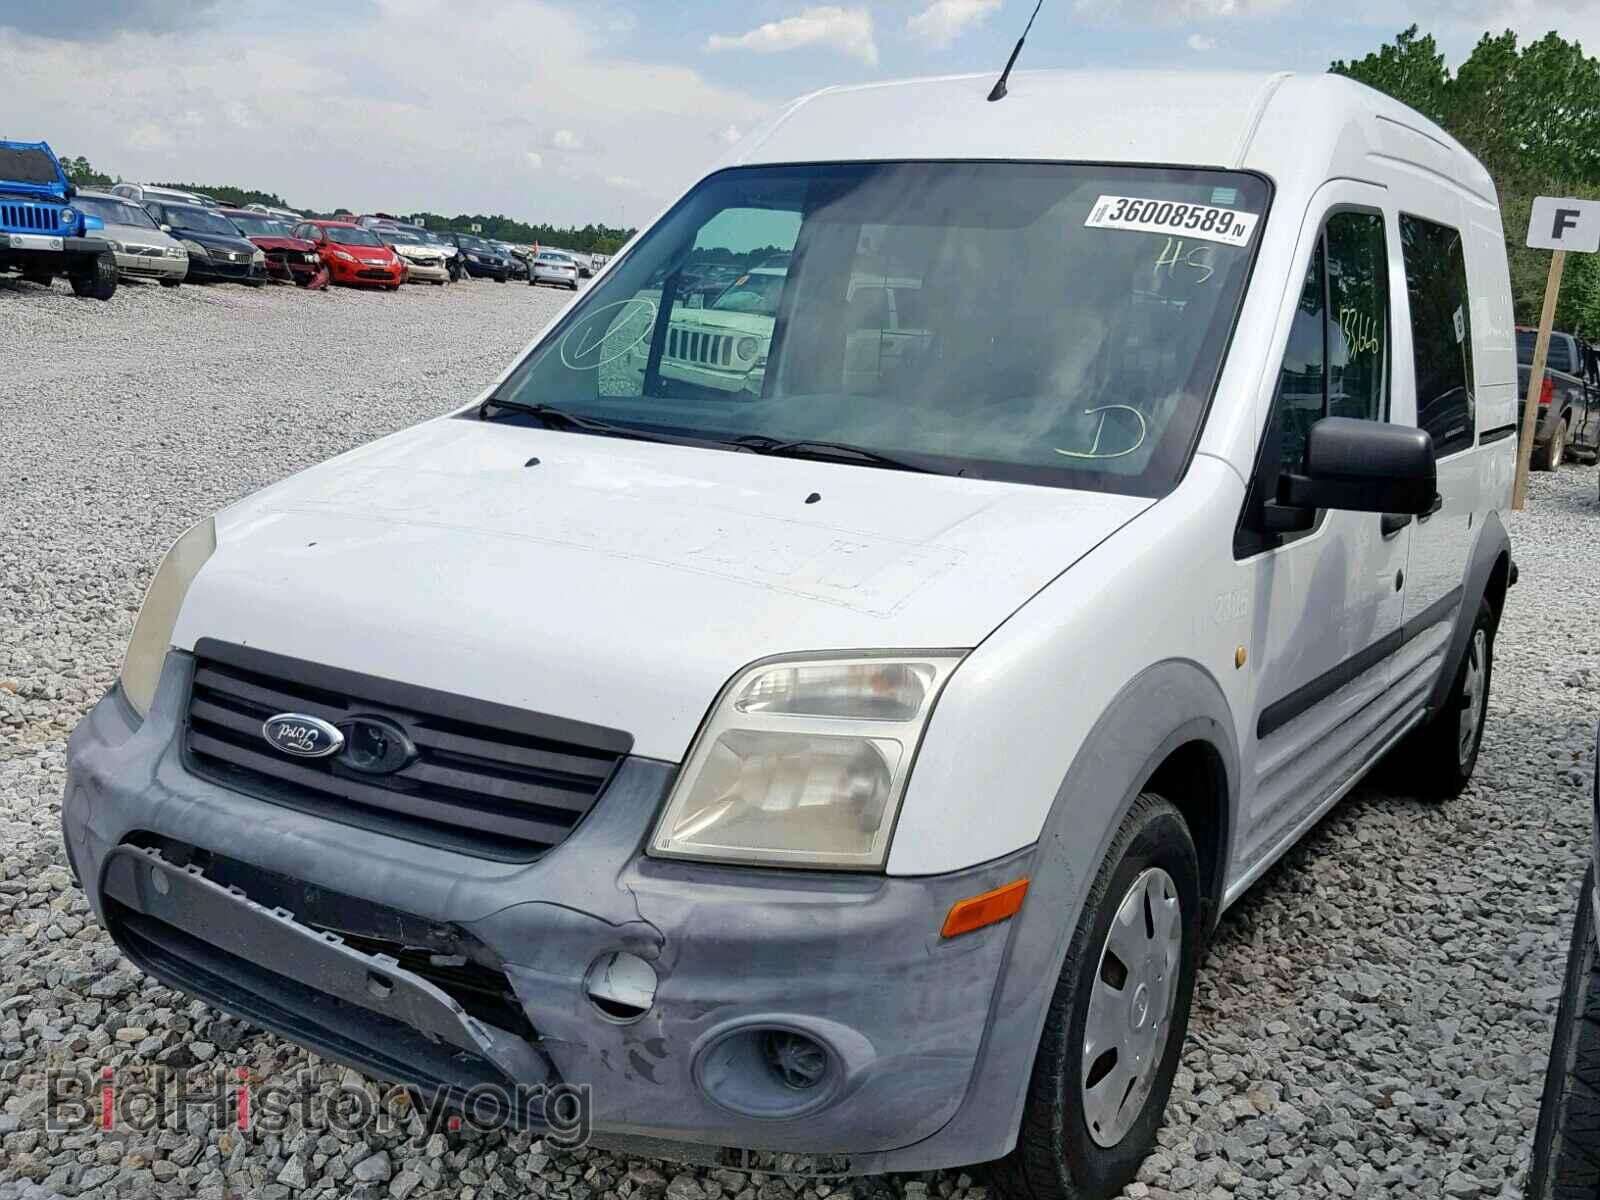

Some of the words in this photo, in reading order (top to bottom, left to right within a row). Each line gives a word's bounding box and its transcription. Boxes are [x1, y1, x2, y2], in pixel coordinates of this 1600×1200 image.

[1109, 198, 1235, 234] 36008589
[1231, 223, 1246, 237] N
[1551, 208, 1581, 239] F
[1054, 404, 1146, 458] D
[278, 723, 319, 751] Ford
